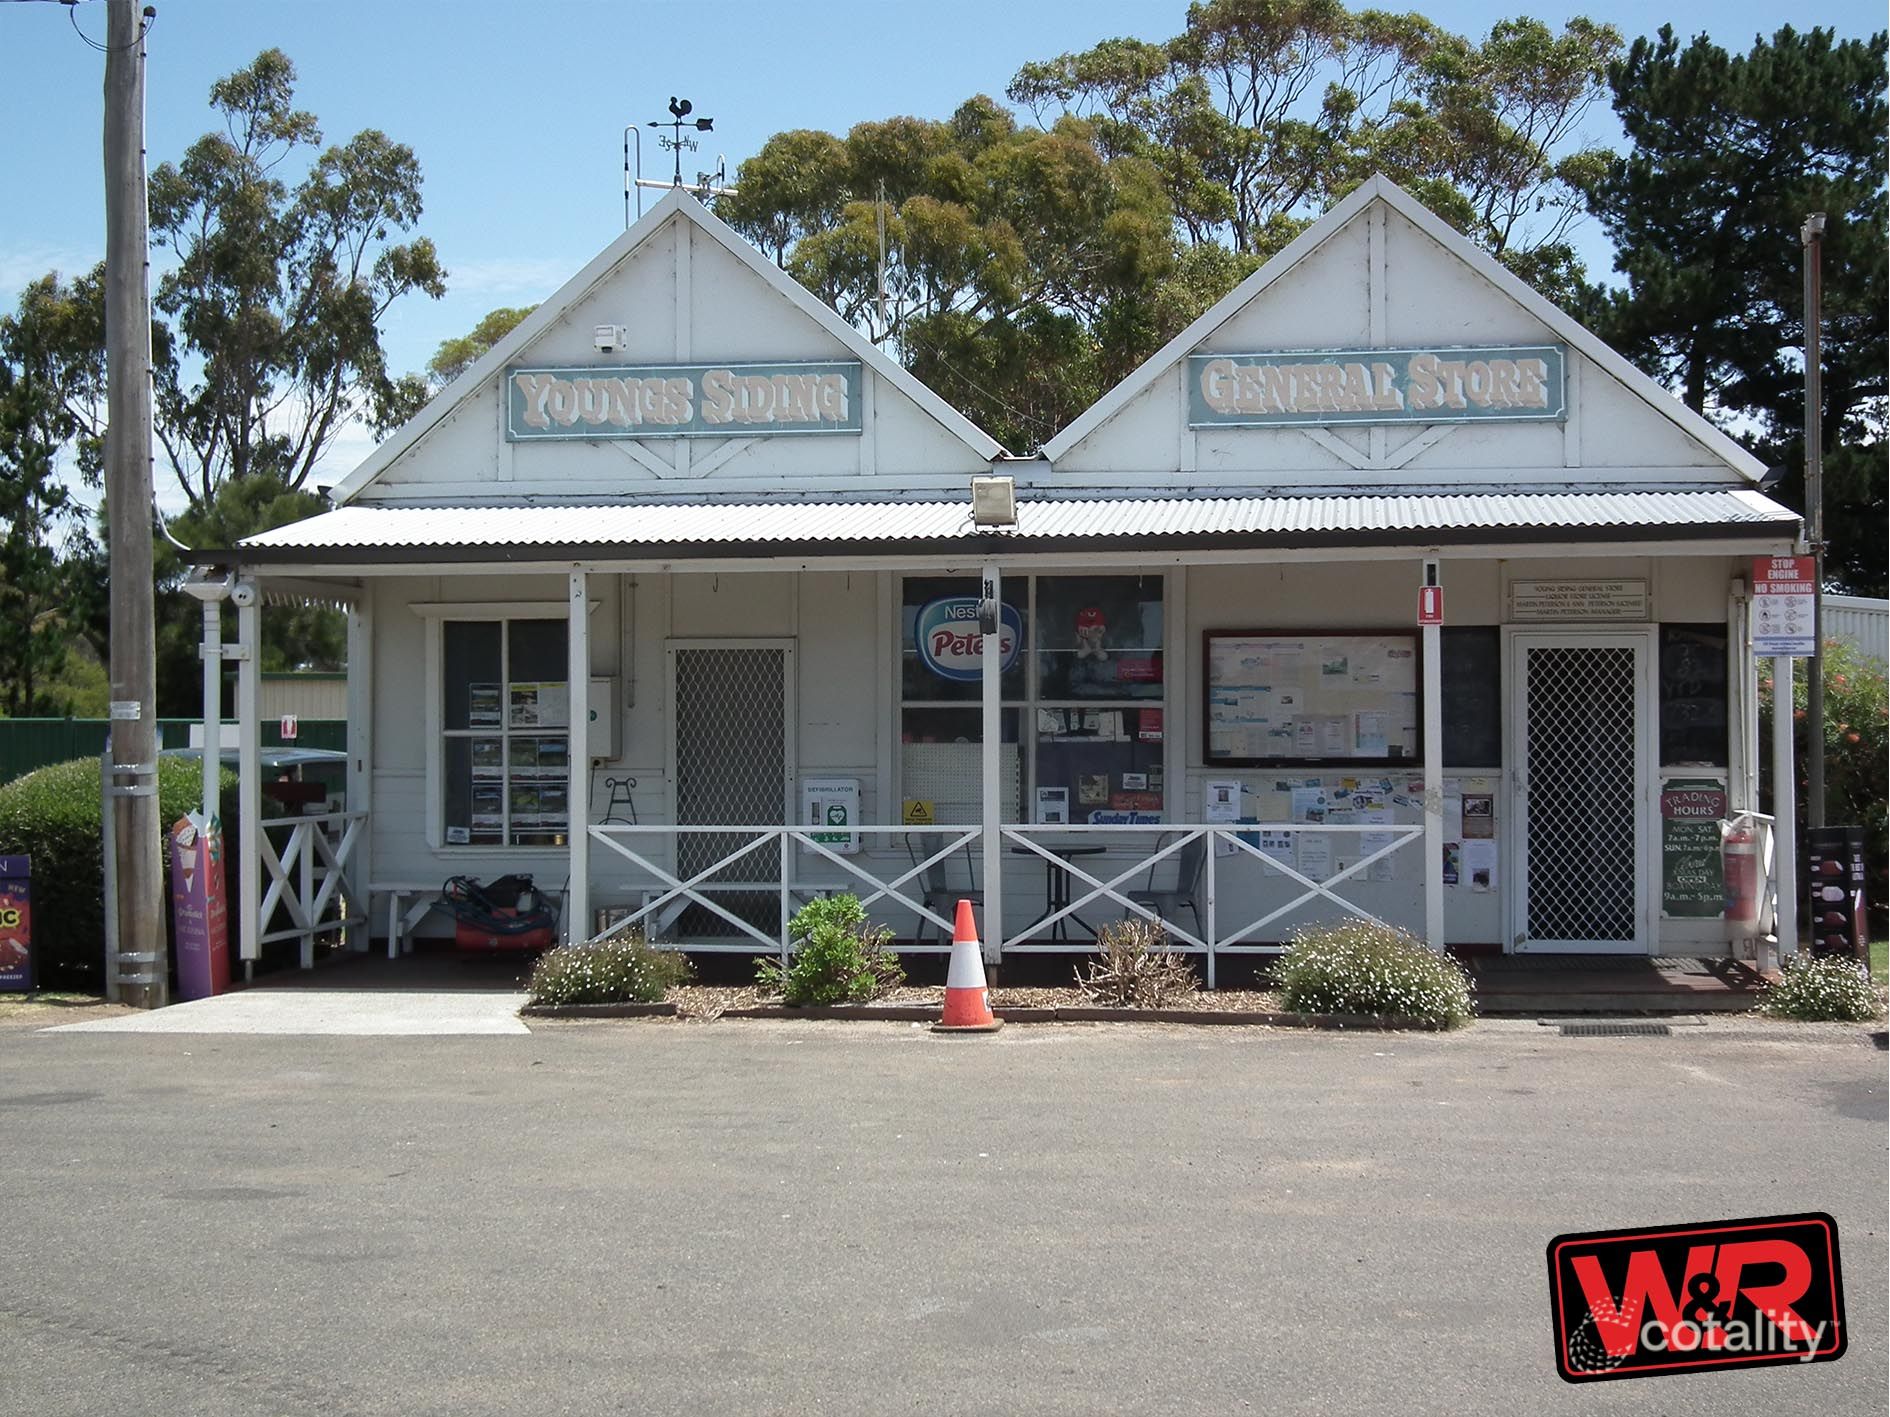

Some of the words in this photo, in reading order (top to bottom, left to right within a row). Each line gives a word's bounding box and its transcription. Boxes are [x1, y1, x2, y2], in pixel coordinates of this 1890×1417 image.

[1201, 358, 1404, 414] GENERAL
[1408, 354, 1548, 409] STORE
[516, 373, 694, 428] YOUNGS
[701, 369, 848, 425] SIDING
[1772, 559, 1795, 568] STOP
[1768, 570, 1799, 580] ENGINE
[1754, 584, 1768, 593] NO
[1770, 583, 1812, 593] SMOKING
[933, 631, 1011, 657] Petes
[1666, 792, 1720, 808] TRADING
[1674, 806, 1714, 816] HOURS
